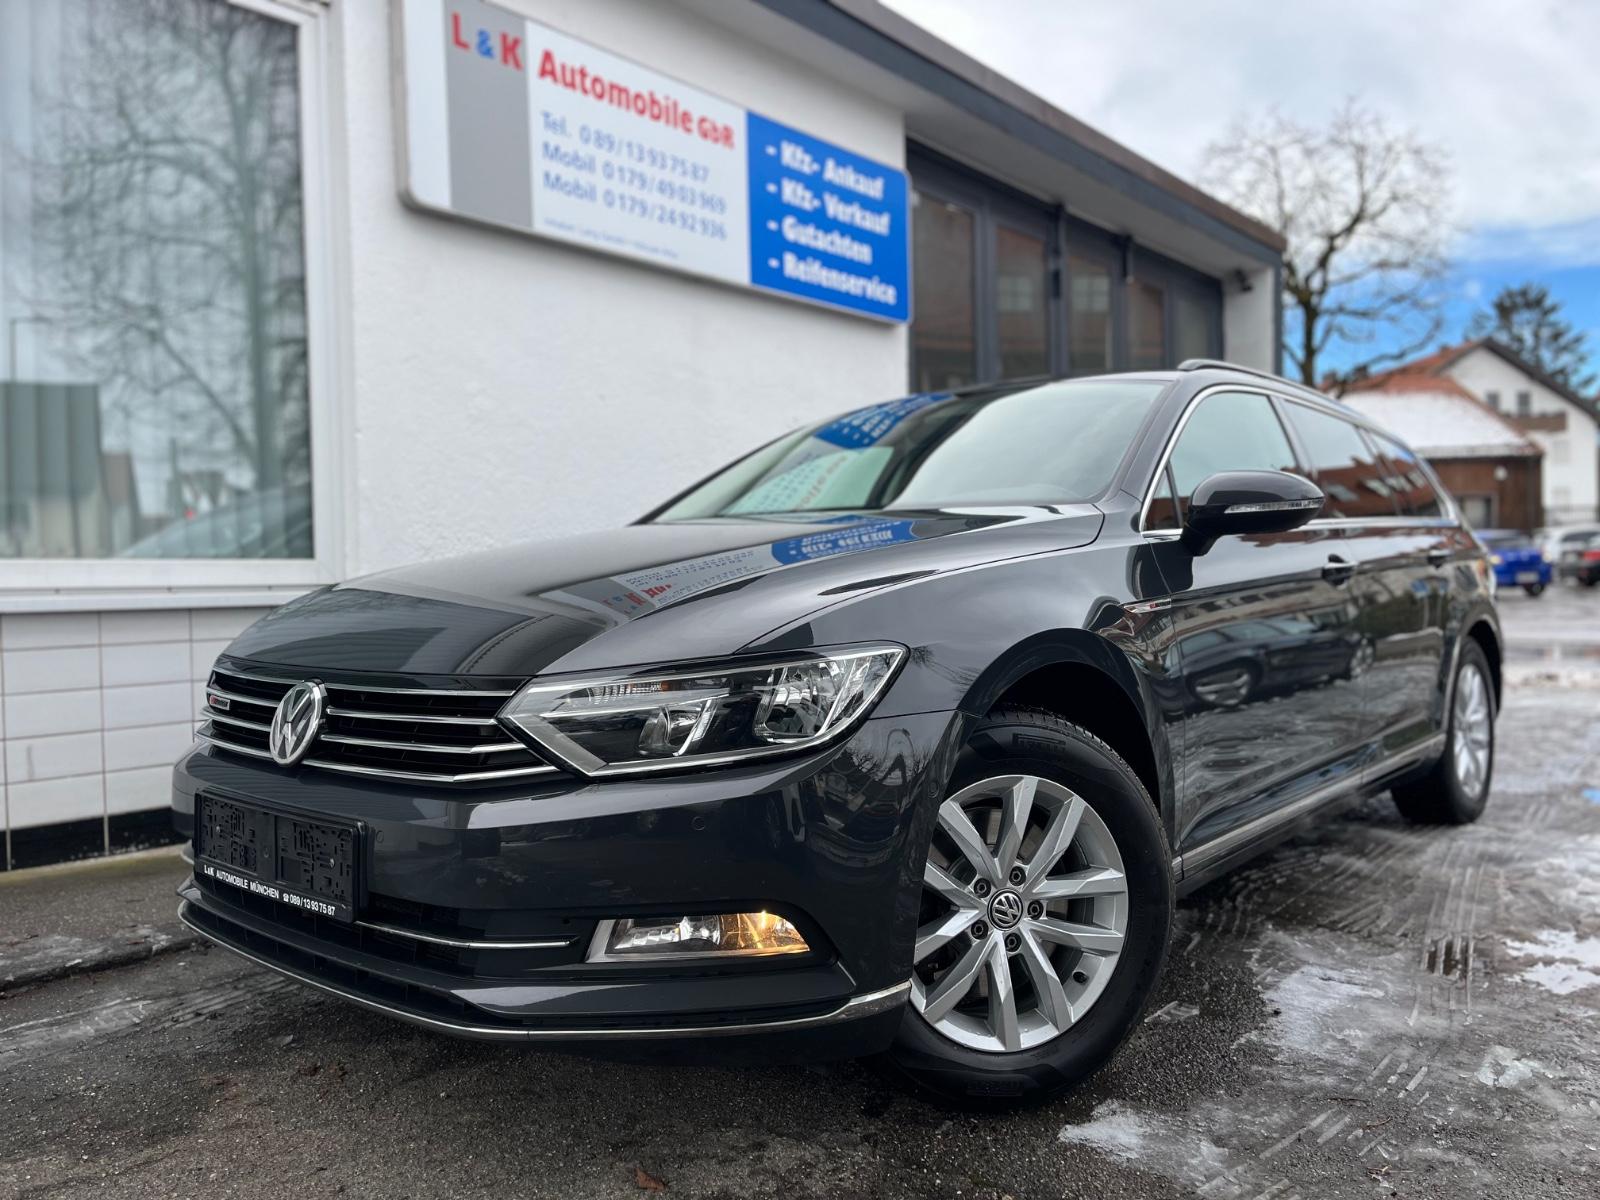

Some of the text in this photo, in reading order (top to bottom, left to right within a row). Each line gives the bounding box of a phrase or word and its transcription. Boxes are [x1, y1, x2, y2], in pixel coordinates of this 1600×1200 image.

[453, 12, 734, 148] L & K Automobile GbR
[542, 111, 571, 137] Tel.
[543, 141, 597, 173] Mobil
[823, 157, 884, 200] Ankauf
[543, 171, 598, 203] Mobil
[823, 192, 890, 236] Verkauf
[782, 215, 873, 266] Gutachten
[783, 251, 897, 305] Reifenservice
[216, 869, 249, 889] AUTOMOBILE
[250, 881, 280, 899] MÜNCHEN
